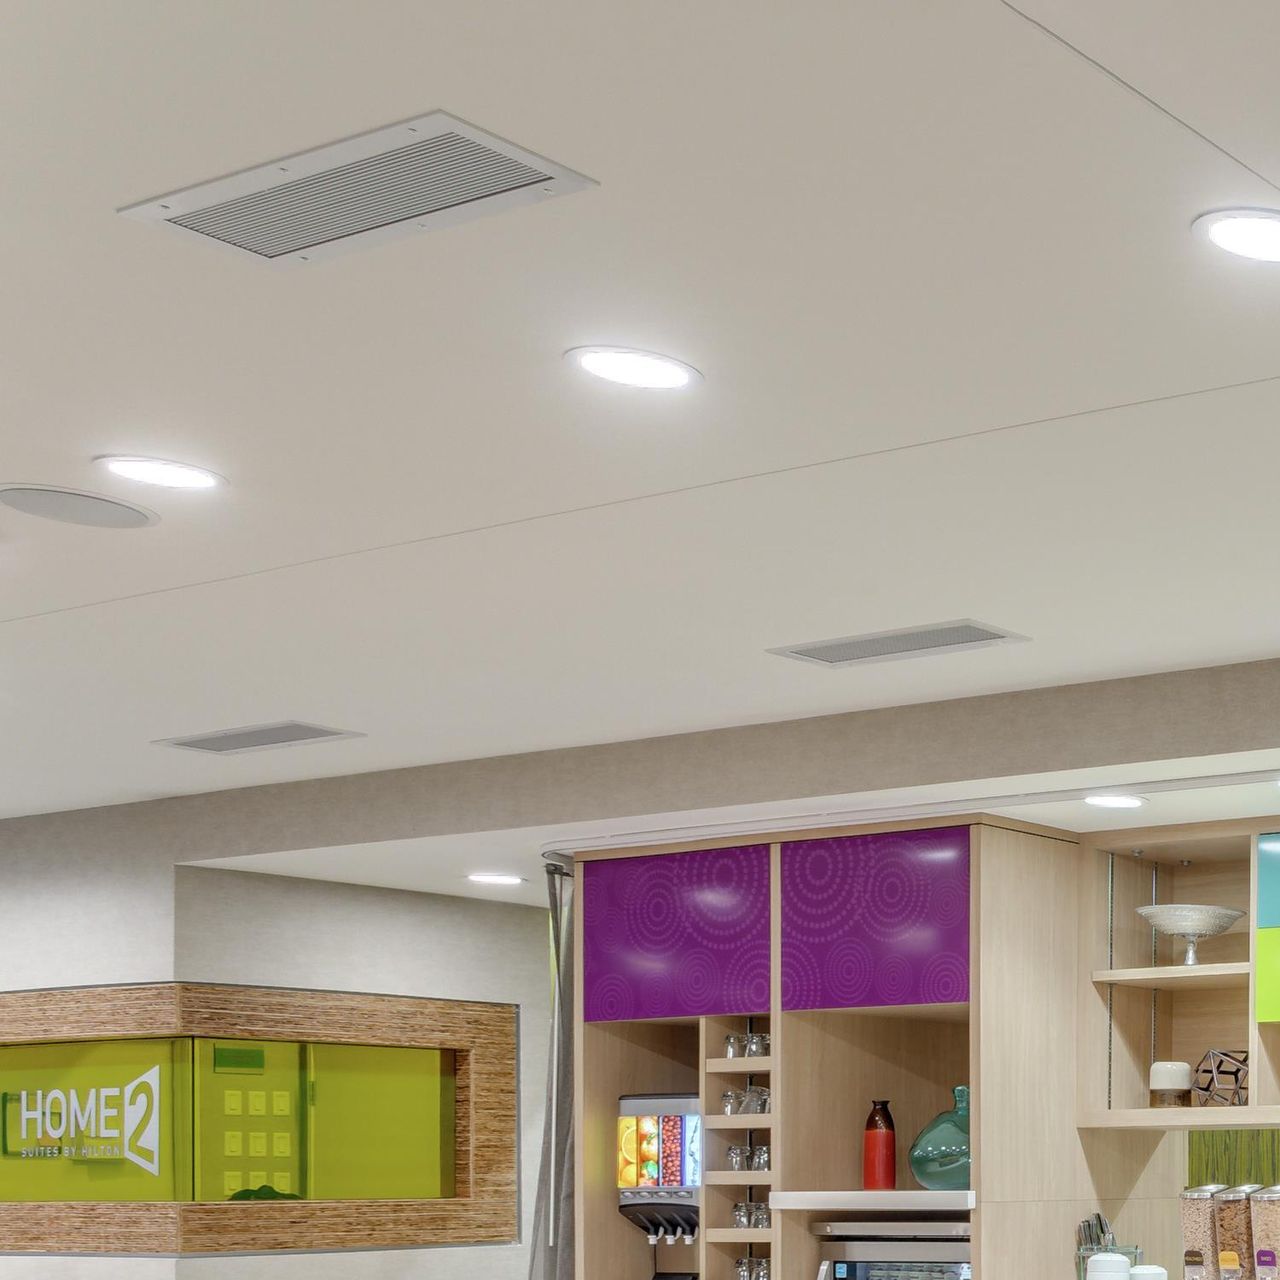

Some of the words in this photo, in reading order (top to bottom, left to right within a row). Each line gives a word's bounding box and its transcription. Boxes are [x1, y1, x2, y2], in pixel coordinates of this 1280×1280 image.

[21, 1147, 59, 1158] SUITES
[64, 1146, 77, 1157] BY
[82, 1145, 120, 1157] HILTON
